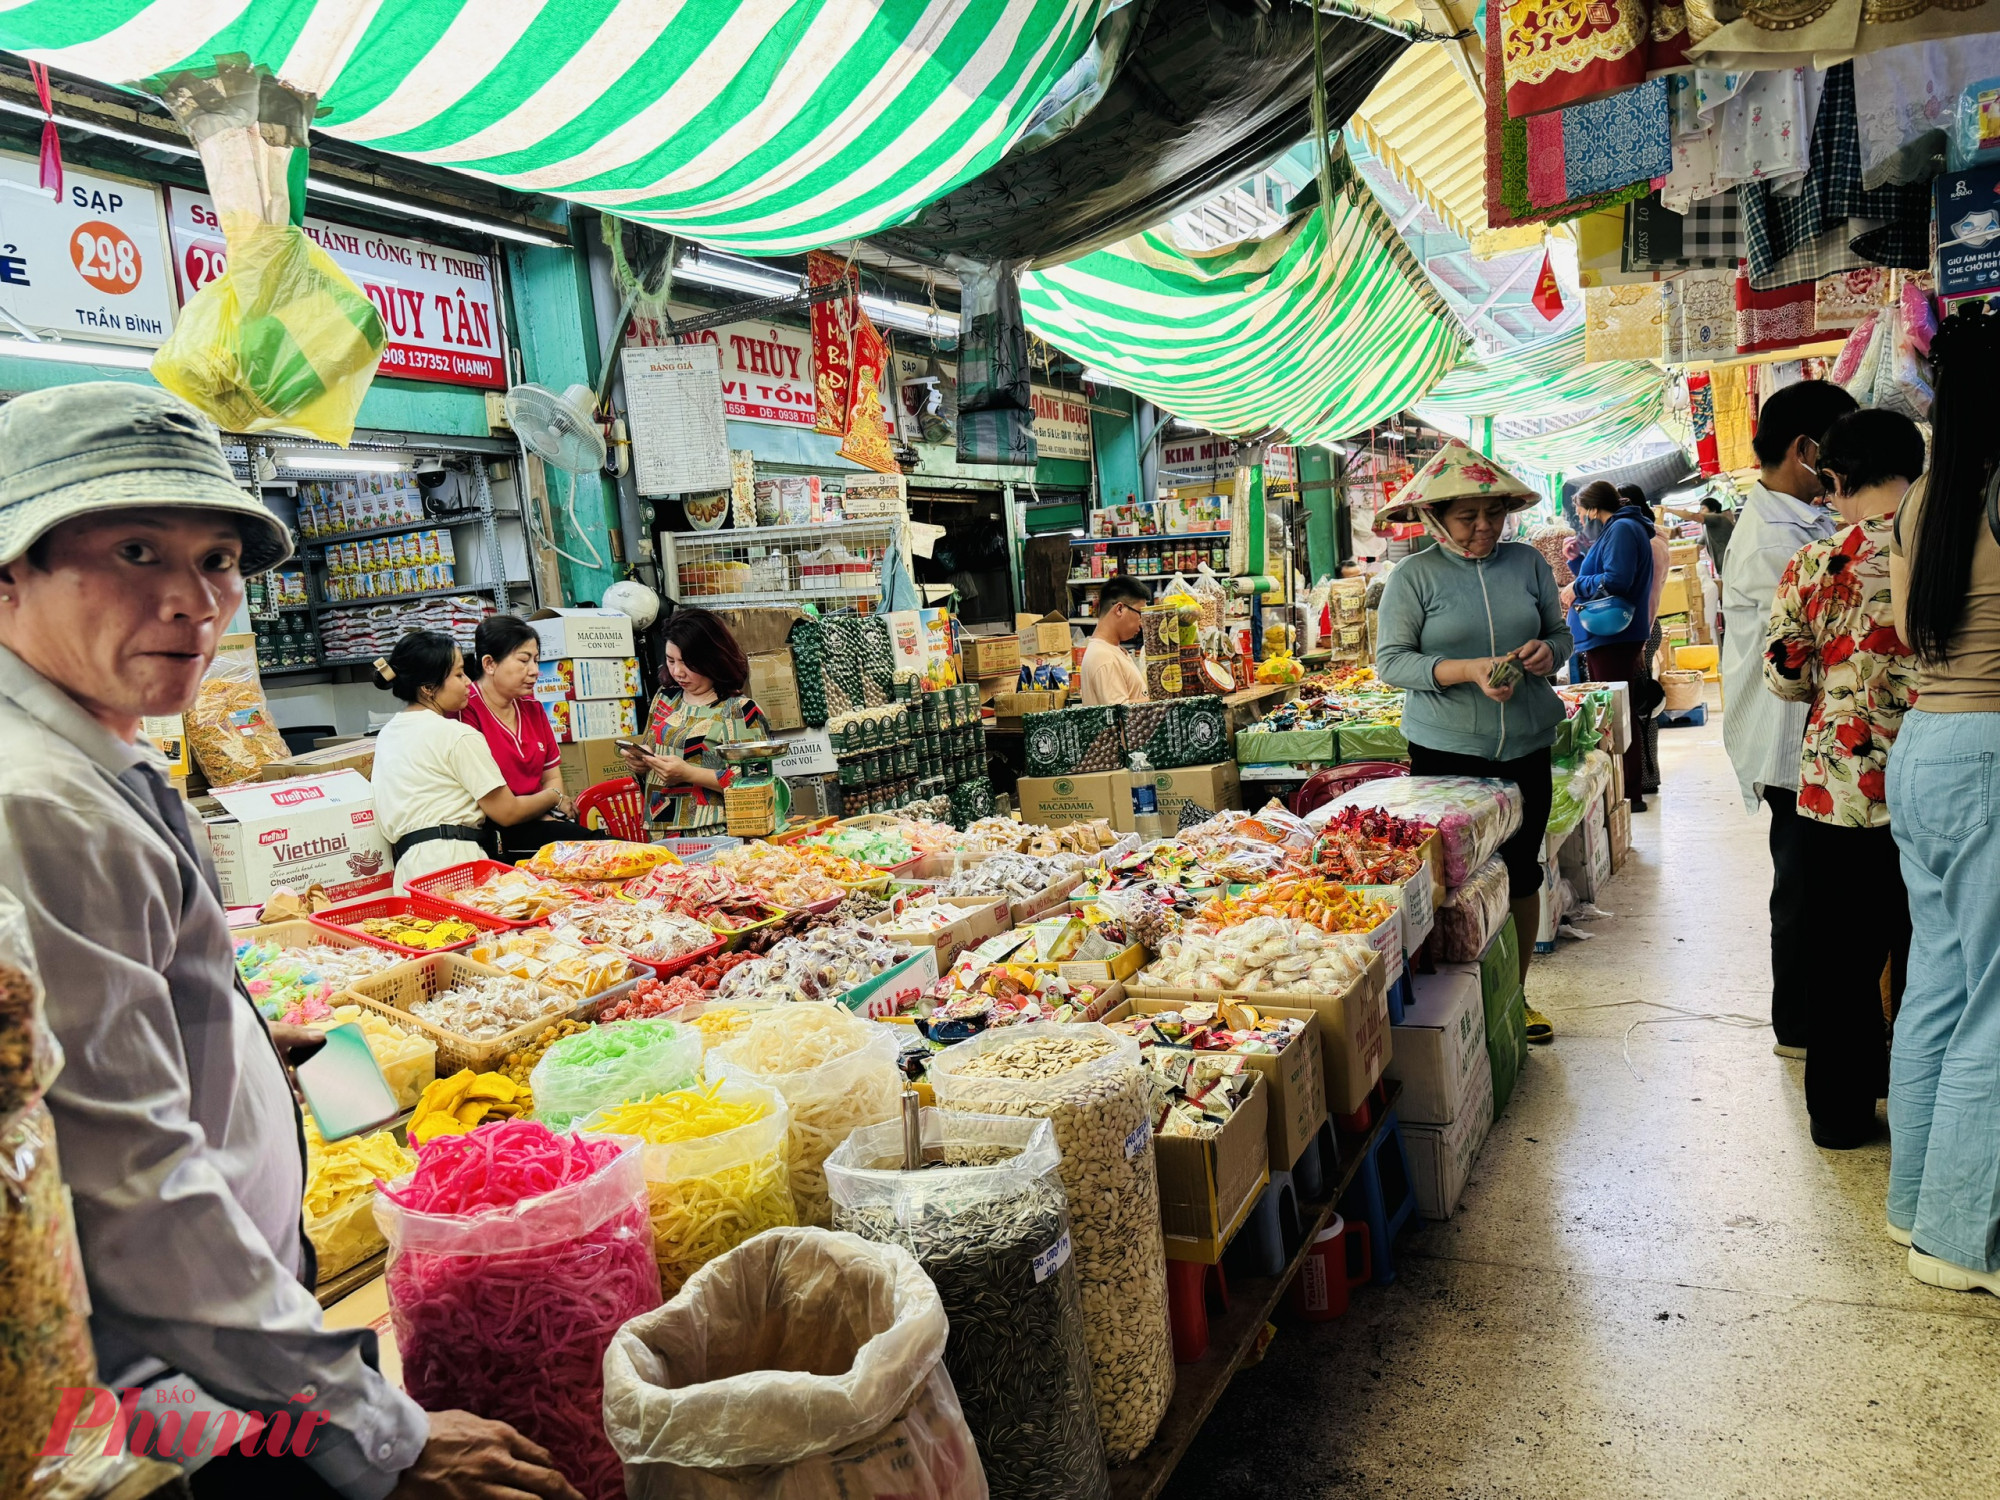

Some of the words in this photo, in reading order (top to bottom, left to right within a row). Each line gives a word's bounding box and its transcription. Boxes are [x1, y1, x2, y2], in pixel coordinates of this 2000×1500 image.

[71, 186, 124, 216] SẠP
[189, 204, 223, 233] Sạ
[76, 231, 138, 285] 298
[302, 226, 361, 256] HÁNH
[364, 237, 412, 266] CÔNG
[440, 255, 487, 281] TNHH
[1977, 251, 1992, 262] KHI
[1947, 266, 1964, 276] CHE
[1983, 260, 1998, 270] KHI
[75, 305, 121, 330] TRẦN
[125, 313, 163, 335] BÌNH
[362, 281, 425, 339] DUY
[434, 285, 492, 350] TÂN
[382, 347, 406, 366] 908
[408, 350, 451, 372] 137352
[452, 354, 493, 379] (HẠNH)
[729, 329, 802, 382] THỦY
[649, 363, 675, 372] BẢNG
[677, 361, 694, 371] GIÁ
[901, 360, 917, 375] SẠP
[721, 380, 748, 402] VỊ
[756, 383, 814, 407] TỔN
[778, 410, 799, 421] 0938
[800, 412, 817, 424] 718
[1164, 446, 1195, 465] KIM
[1200, 440, 1236, 460] MIN
[577, 631, 624, 641] MACADAMIA
[587, 641, 605, 650] CON
[788, 743, 822, 756] ADAMIA
[780, 757, 798, 768] CON
[798, 756, 813, 765] VOI
[1038, 802, 1095, 811] MACADAMIA
[272, 832, 348, 862] Vietthai
[270, 873, 309, 887] Chocolate
